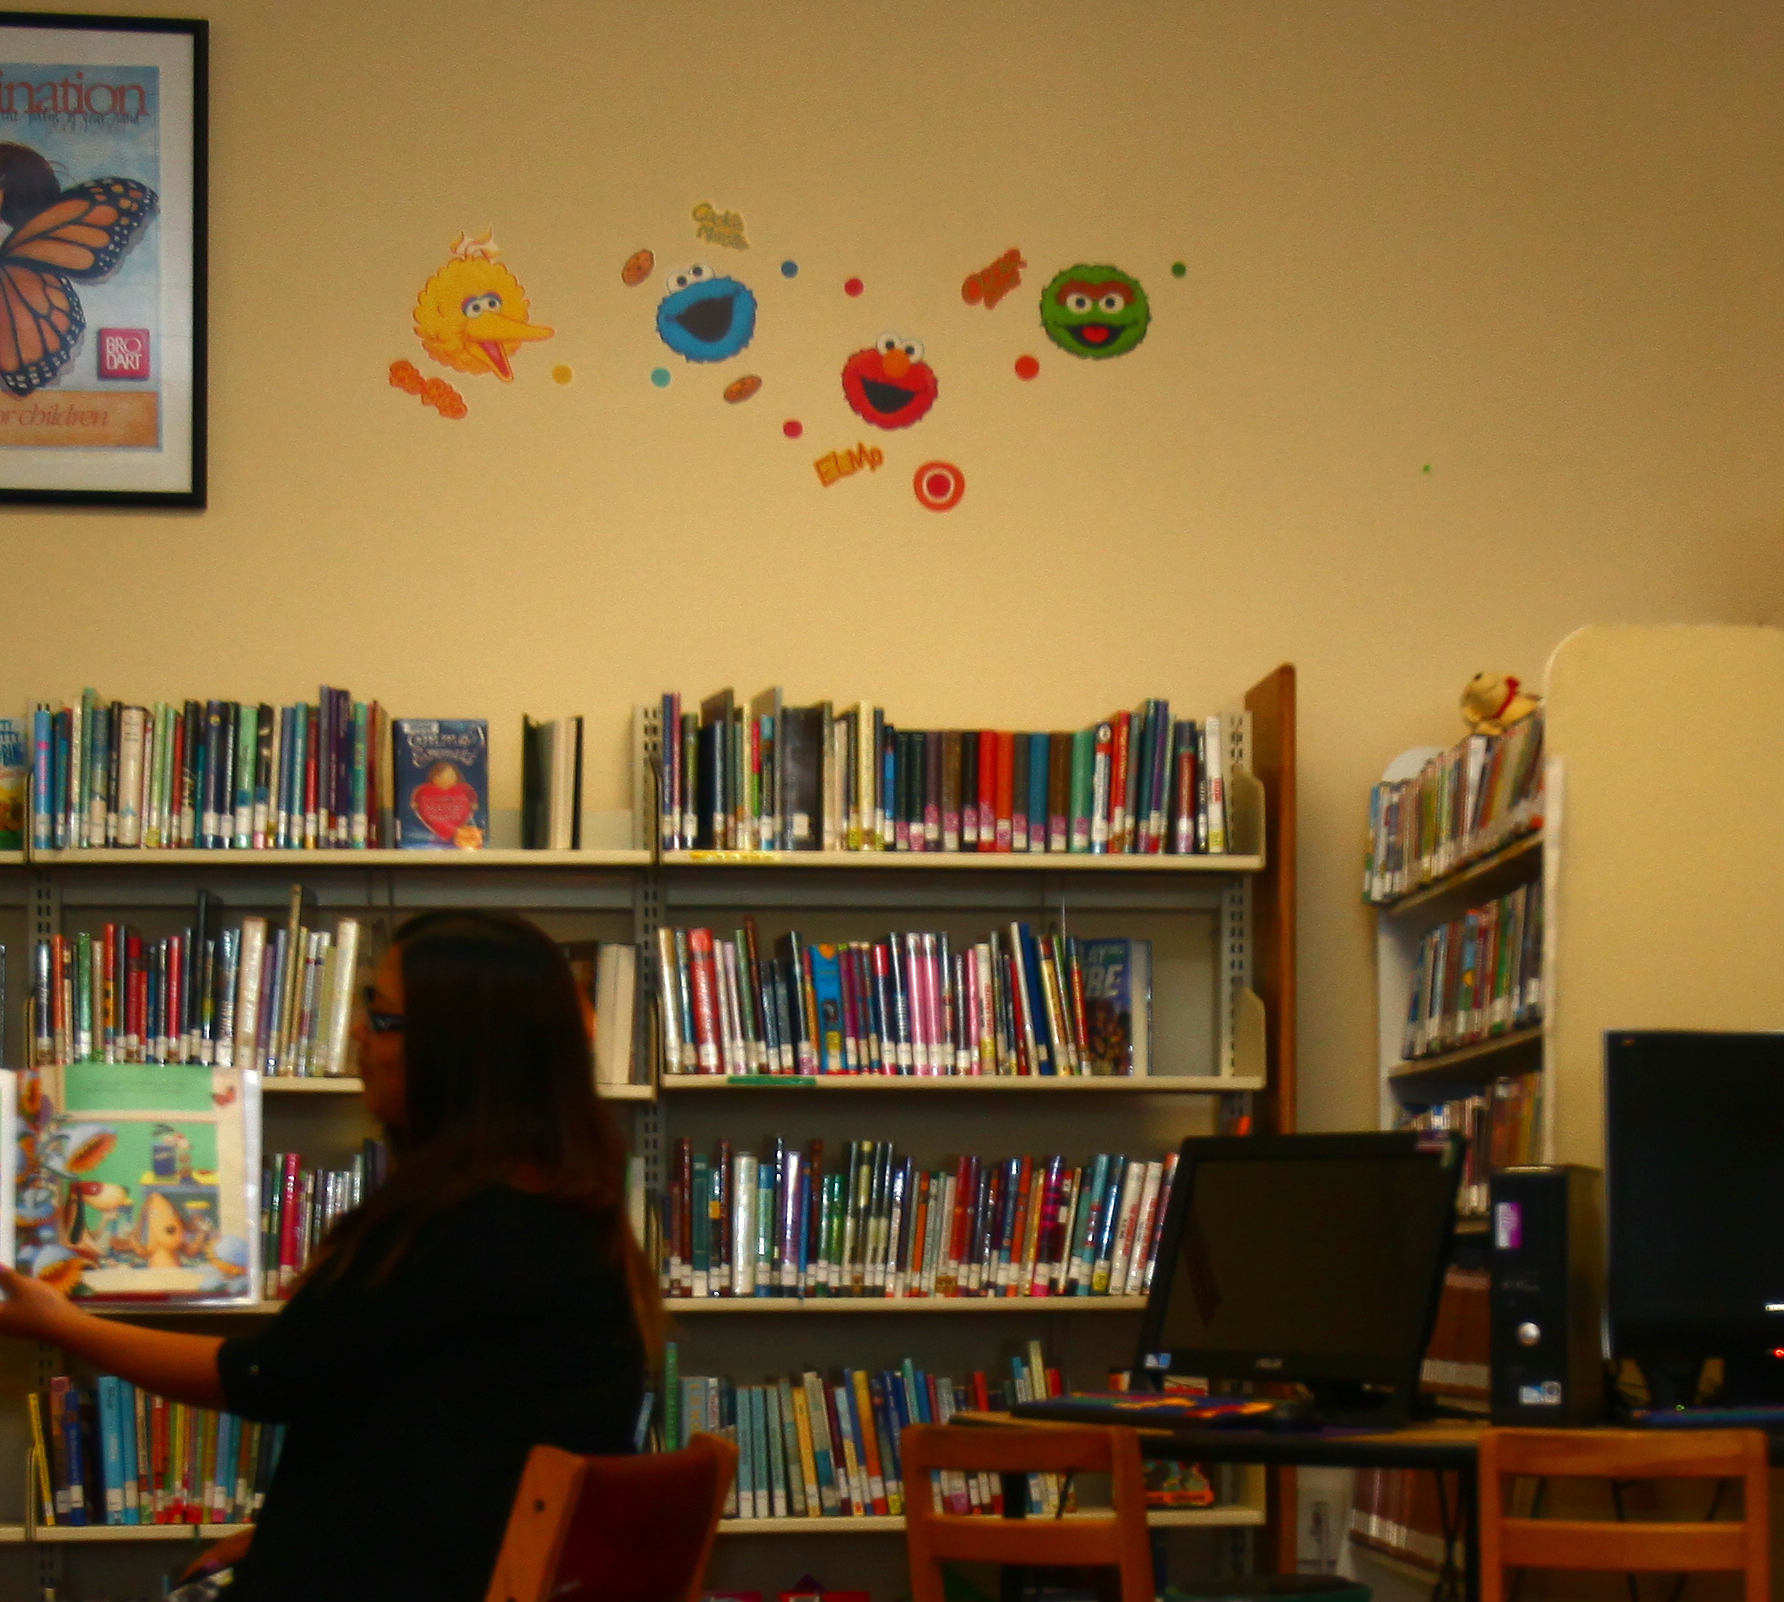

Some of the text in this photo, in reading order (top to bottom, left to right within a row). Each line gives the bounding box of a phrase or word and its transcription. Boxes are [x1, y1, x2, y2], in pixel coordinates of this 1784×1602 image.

[106, 337, 141, 350] BRO
[106, 351, 142, 370] DART
[19, 404, 109, 427] children
